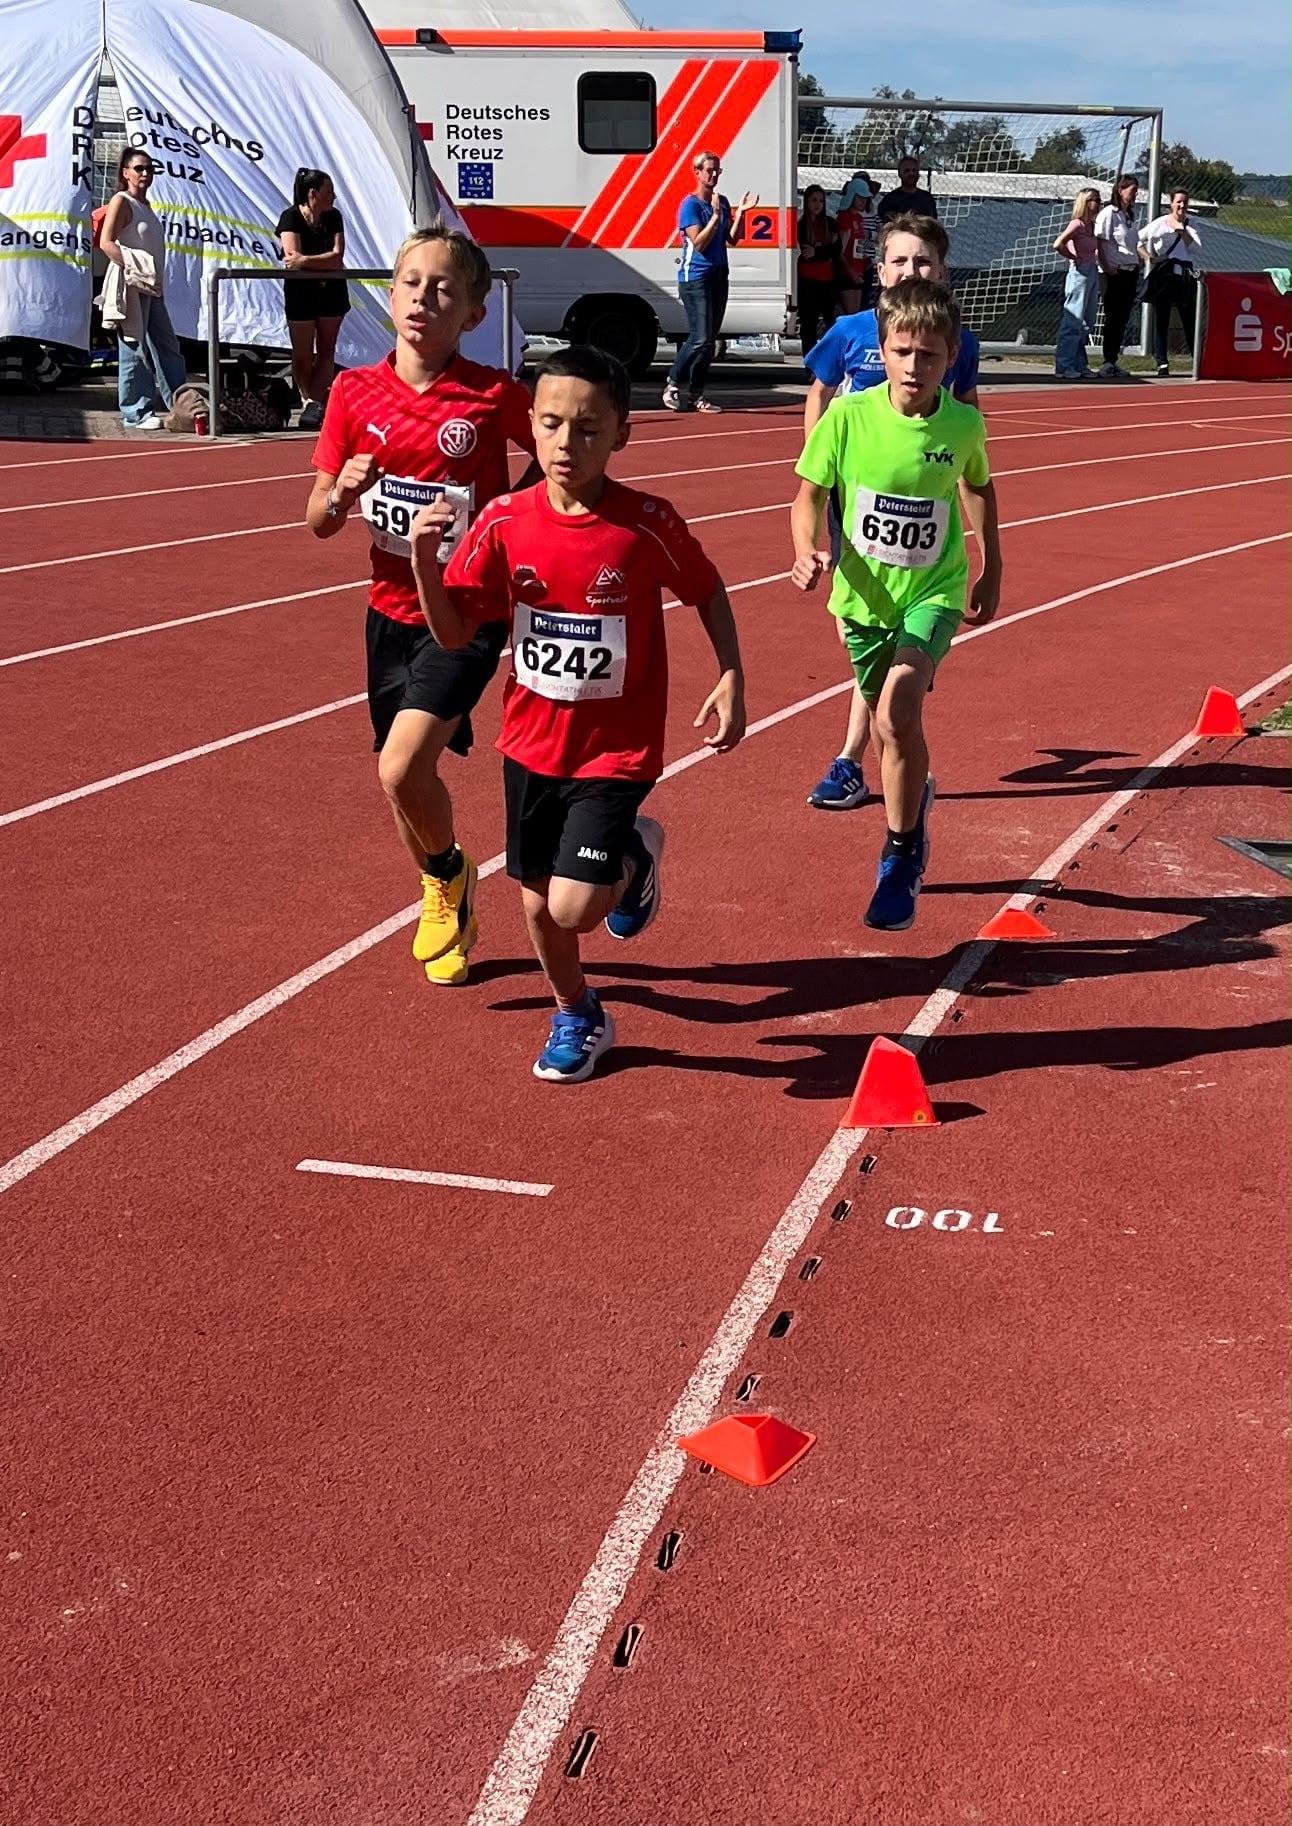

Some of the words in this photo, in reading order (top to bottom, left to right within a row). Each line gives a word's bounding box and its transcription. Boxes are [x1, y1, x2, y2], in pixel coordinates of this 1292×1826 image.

[446, 104, 551, 120] Deutsches
[446, 124, 504, 141] Rotes
[446, 144, 504, 160] Kreuz
[384, 481, 436, 500] Peterstale
[879, 498, 931, 513] Peterstaler
[862, 514, 937, 550] 6303
[534, 616, 597, 635] Peterstaler
[522, 637, 613, 680] 6242
[577, 846, 608, 861] JAKO
